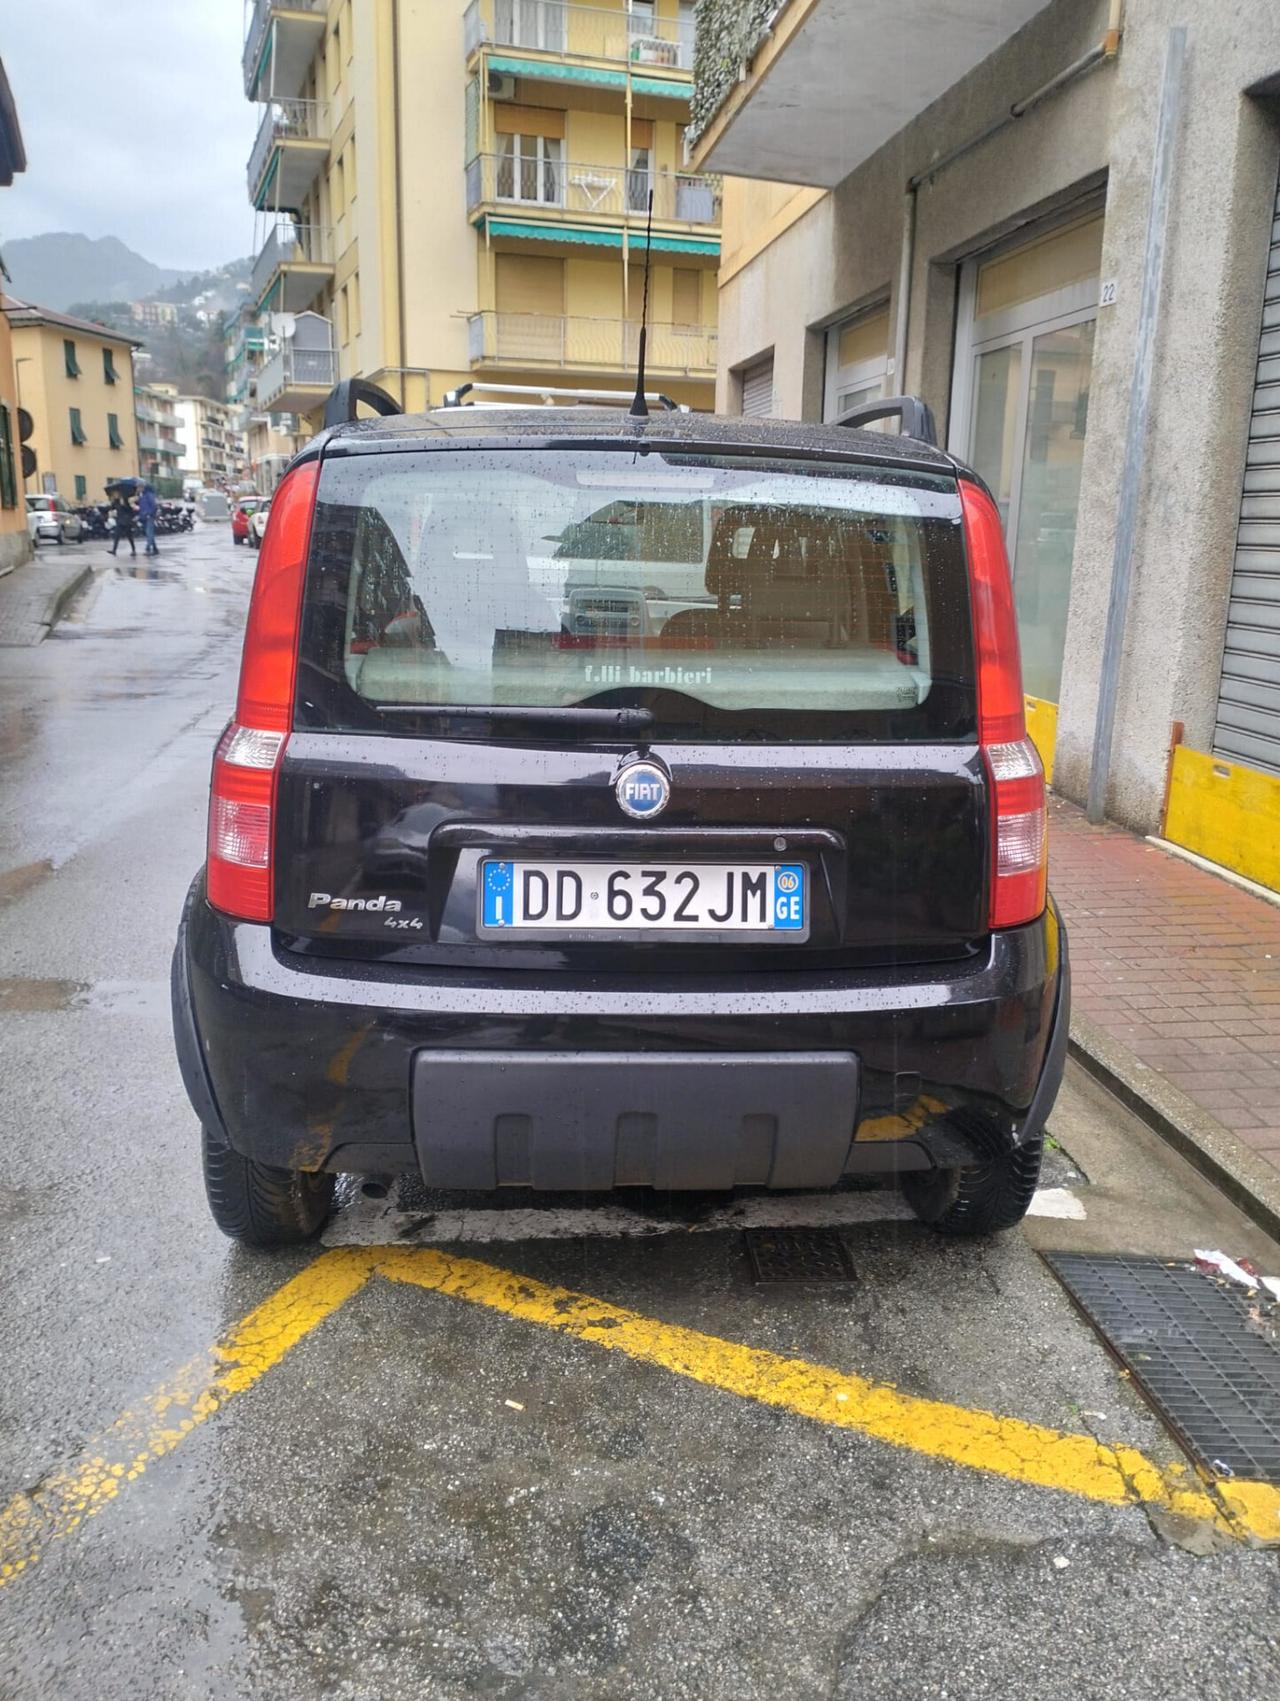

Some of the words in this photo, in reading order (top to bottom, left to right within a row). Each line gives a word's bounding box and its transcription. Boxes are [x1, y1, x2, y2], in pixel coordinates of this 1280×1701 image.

[1103, 283, 1115, 303] 22
[629, 666, 712, 684] barbieri
[625, 783, 660, 800] FIAT
[781, 876, 795, 889] 06
[307, 892, 402, 912] Panda
[522, 870, 583, 921] DD
[776, 896, 800, 920] GE
[383, 916, 423, 929] 4x4
